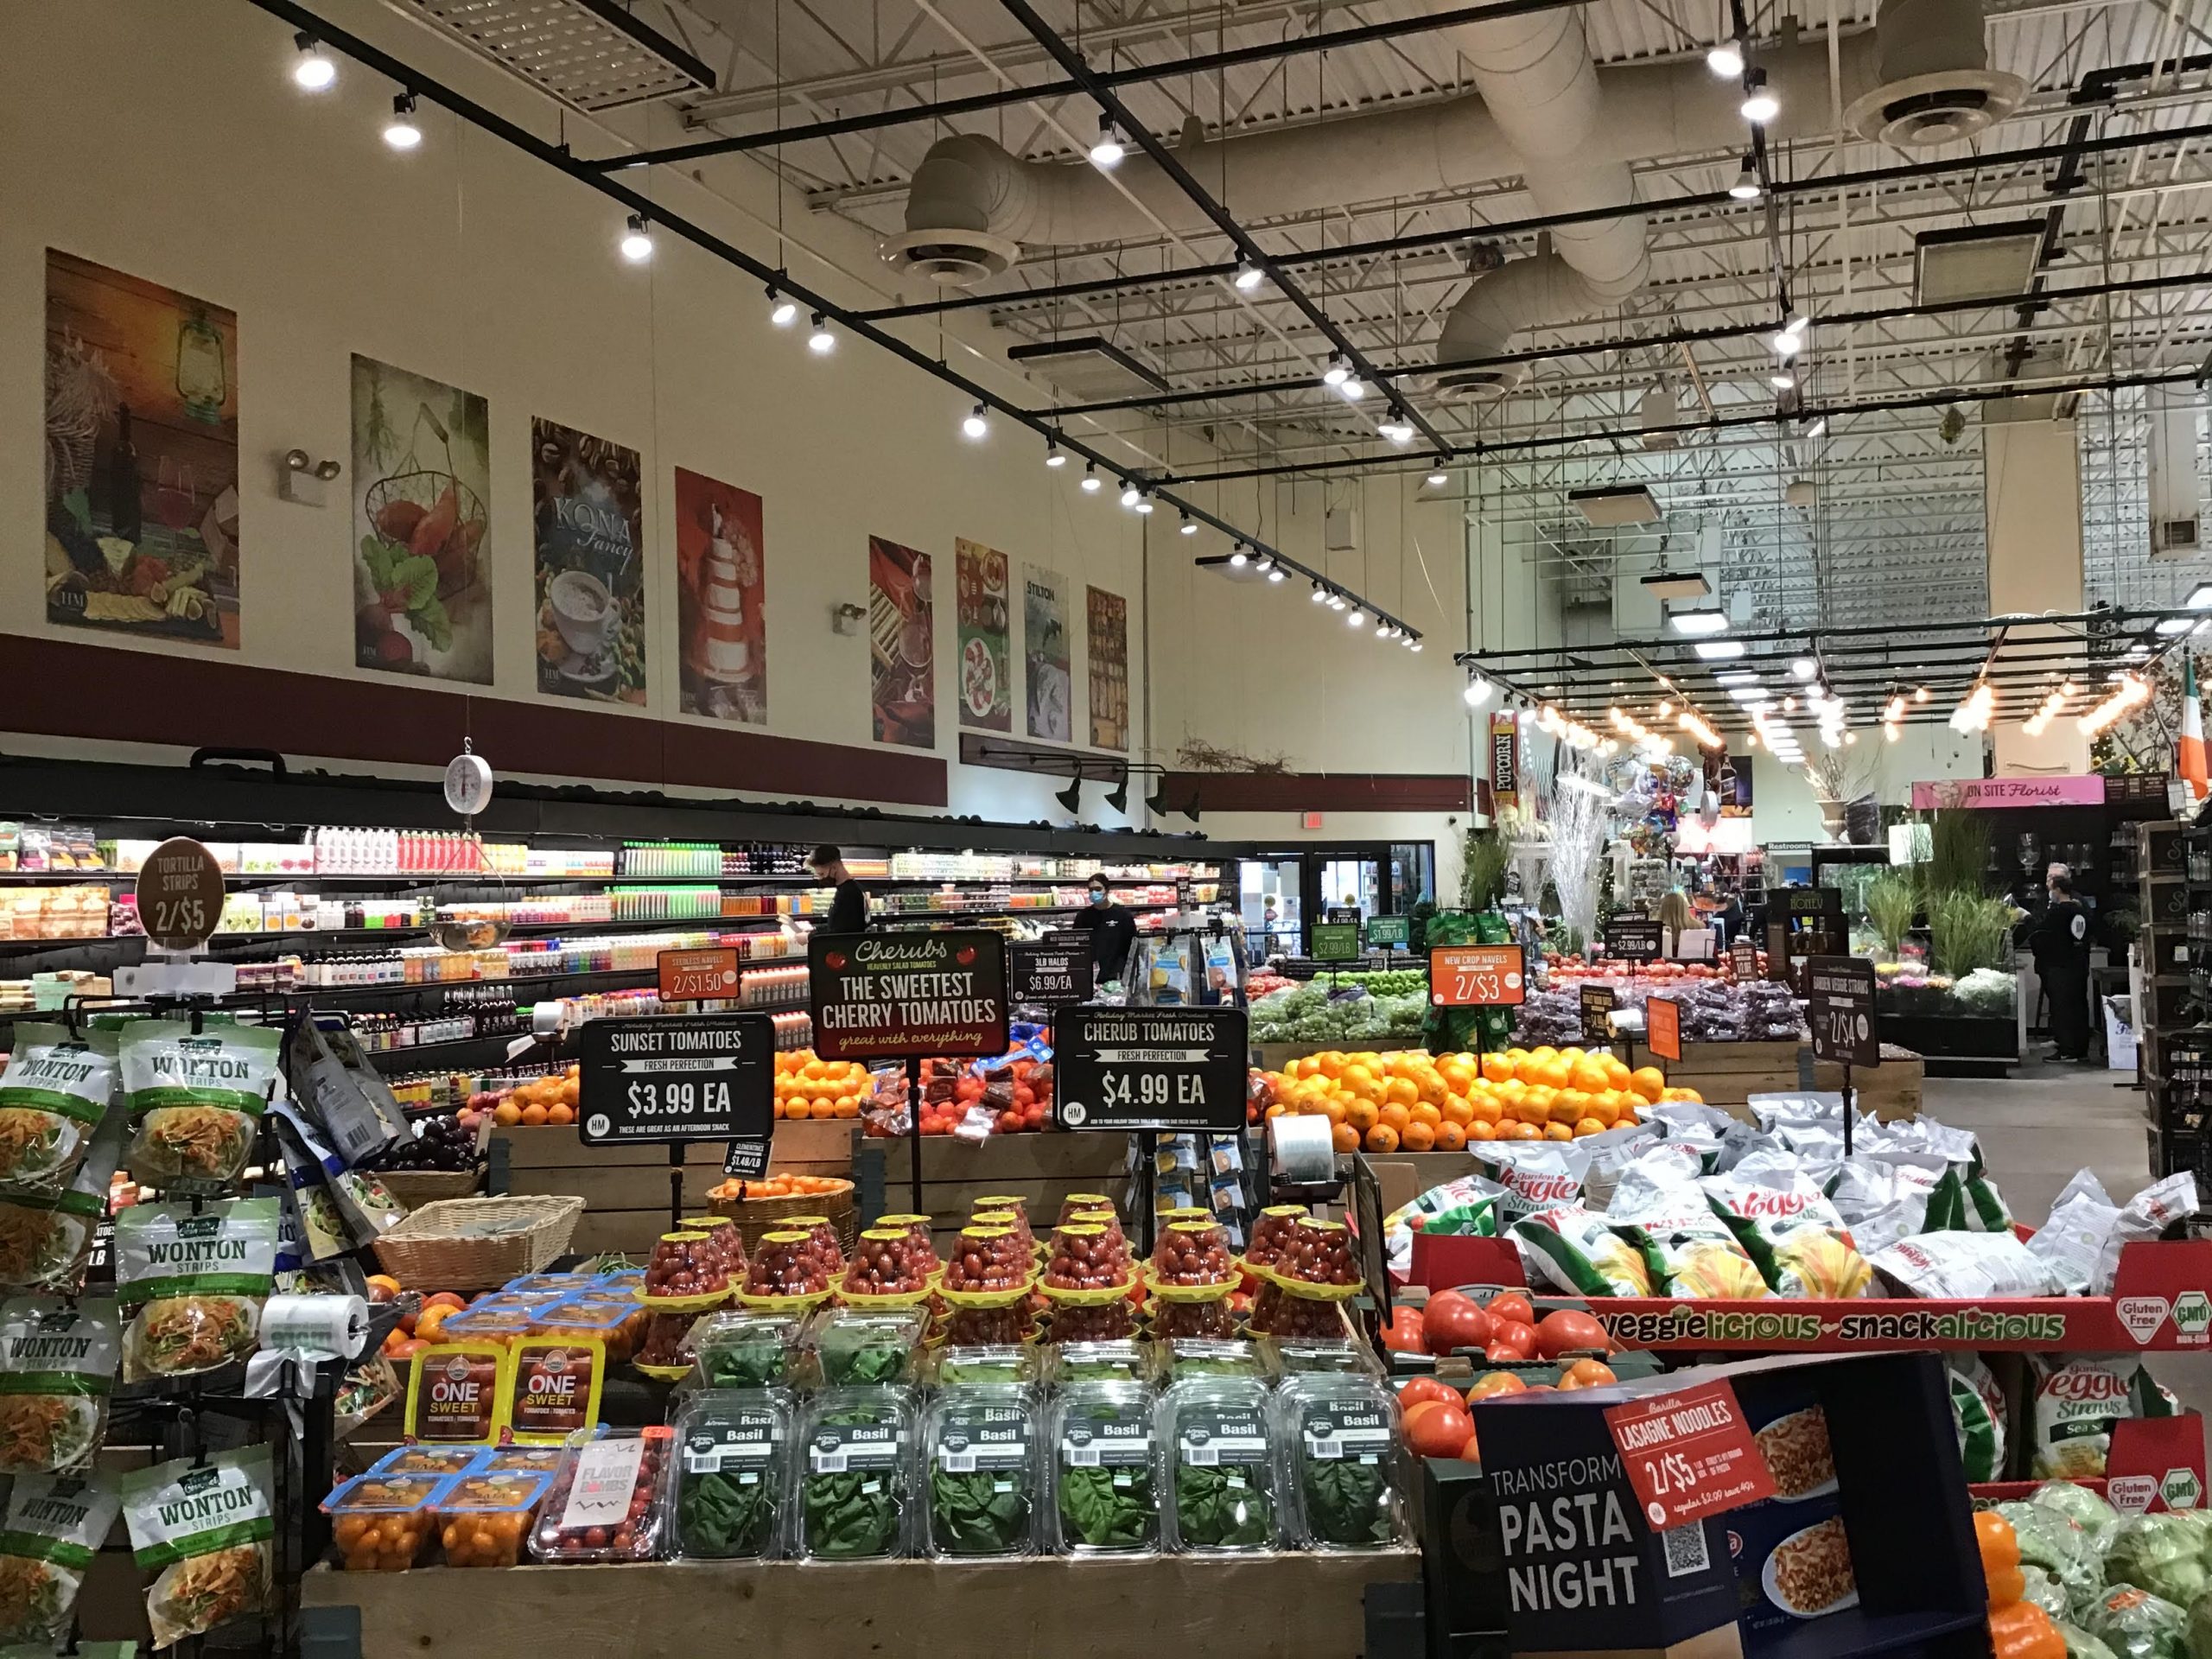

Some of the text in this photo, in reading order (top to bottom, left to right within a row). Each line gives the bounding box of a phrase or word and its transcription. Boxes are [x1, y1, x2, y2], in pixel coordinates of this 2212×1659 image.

[553, 497, 631, 543] KONA
[576, 532, 633, 575] Fancy
[61, 592, 85, 607] HM
[1027, 581, 1055, 602] STILTON
[1497, 734, 1511, 791] POPCORN
[1984, 784, 2005, 796] SITE
[2007, 783, 2061, 796] Florist
[156, 855, 205, 874] TORTILLA
[162, 874, 199, 891] STRIPS
[156, 896, 205, 935] 2/$5
[855, 939, 947, 962] Cherubs
[1618, 940, 1645, 950] $2.99/LB
[1035, 957, 1069, 967] 3LB HALOS
[1445, 955, 1508, 965] NEW CROP NAVELS
[674, 973, 721, 994] 2/$1.50
[840, 972, 973, 1001] THE SWEETEST
[1029, 974, 1072, 991] $6.99/EA
[1456, 972, 1499, 1001] 2/$3
[823, 999, 996, 1028] CHERRY TOMATOES
[1084, 1023, 1215, 1041] CHERUB TOMATOES
[1830, 1010, 1855, 1048] 2/$4
[611, 1031, 741, 1052] SUNSET TOMATOES
[839, 1030, 982, 1052] great with everything
[645, 1058, 715, 1071] FRESH PERFECTION
[1118, 1051, 1186, 1061] FRESH PERFECTION
[18, 1059, 95, 1083] WONTON
[151, 1057, 250, 1079] WONTON
[1102, 1070, 1205, 1109] $4.99 EA
[627, 1080, 731, 1119] $3.99 EA
[1068, 1108, 1081, 1119] HM
[591, 1120, 605, 1130] HM
[731, 1155, 761, 1167] $1.49/LB
[1497, 1162, 1578, 1202] Veggie
[1517, 1172, 1555, 1181] garden
[147, 1240, 247, 1264] WONTON
[177, 1262, 219, 1274] STRIPS
[2123, 1302, 2163, 1315] Gluten
[2177, 1306, 2207, 1322] GMO
[1599, 1303, 2066, 1342] veggielicious snackalicious
[2130, 1314, 2156, 1325] Free
[10, 1338, 92, 1358] WONTON
[26, 1359, 59, 1370] STRIPS
[432, 1382, 480, 1402] ONE
[528, 1375, 576, 1395] ONE
[429, 1402, 478, 1414] SWEET
[526, 1394, 575, 1406] SWEET
[1649, 1398, 1682, 1414] Barilla
[2056, 1400, 2121, 1420] Straws
[1221, 1423, 1257, 1435] Basil
[1344, 1414, 1379, 1427] Basil
[1618, 1400, 1732, 1452] LASAGNE NOODLES
[2067, 1424, 2088, 1434] Sea
[727, 1428, 763, 1441] Basil
[852, 1428, 889, 1440] Basil
[981, 1428, 1017, 1441] Basil
[1103, 1424, 1140, 1436] Basil
[582, 1465, 632, 1480] FLAVOR
[1491, 1453, 1622, 1497] TRANSFORM
[1645, 1452, 1696, 1496] 2/$5
[2112, 1483, 2151, 1495] Gluten
[2166, 1482, 2196, 1500] GMO
[158, 1484, 254, 1526] WONTON
[1674, 1498, 1701, 1516] regular
[1700, 1492, 1723, 1505] $2.99
[2120, 1495, 2145, 1506] Free
[19, 1498, 90, 1528] WONTON
[192, 1513, 231, 1531] STRIPS
[1500, 1491, 1633, 1556] PASTA
[1508, 1556, 1638, 1612] NIGHT
